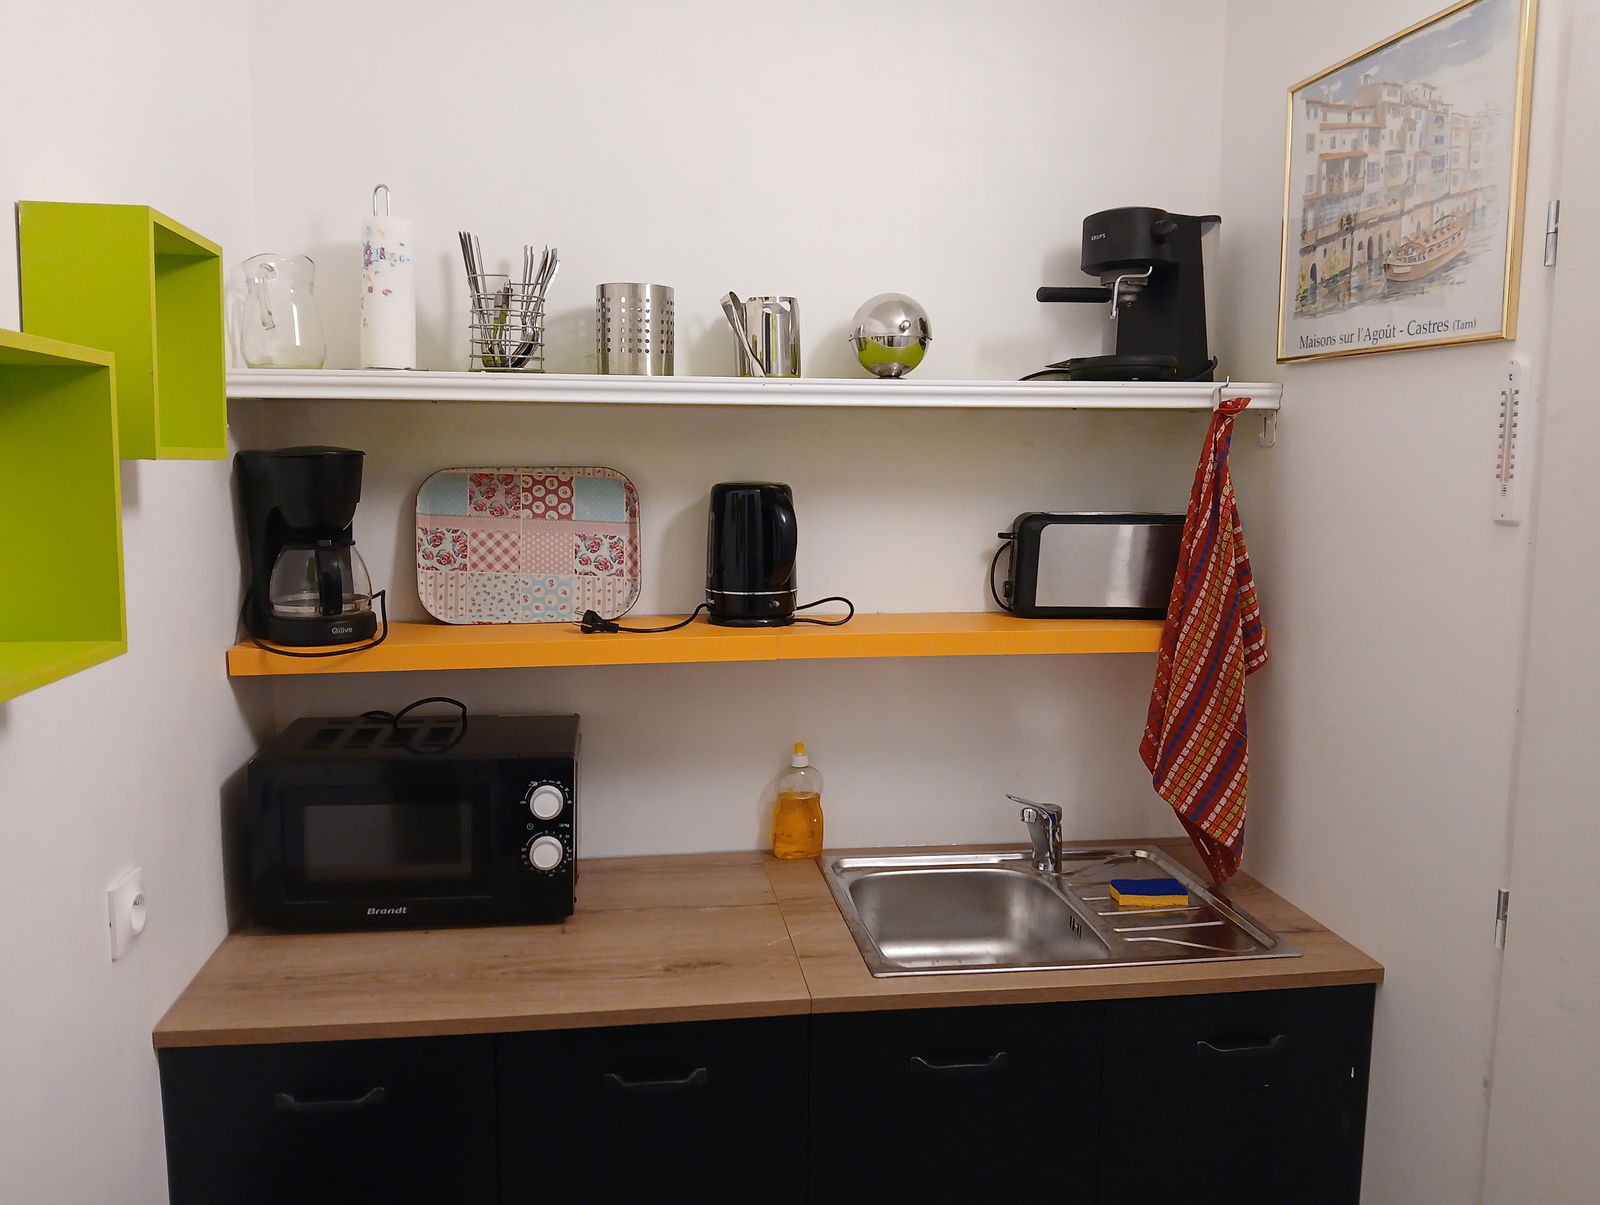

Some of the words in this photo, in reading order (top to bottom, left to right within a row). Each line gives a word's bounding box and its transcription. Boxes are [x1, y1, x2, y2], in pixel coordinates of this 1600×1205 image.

[1091, 232, 1106, 241] KRUPS
[1299, 334, 1336, 349] Maisons
[1339, 333, 1355, 345] sur
[1357, 324, 1396, 345] l'Agoût
[1407, 320, 1450, 336] Castres
[1452, 317, 1477, 333] (Tarn)
[331, 627, 353, 635] Qilive
[366, 906, 408, 916] Brandt
